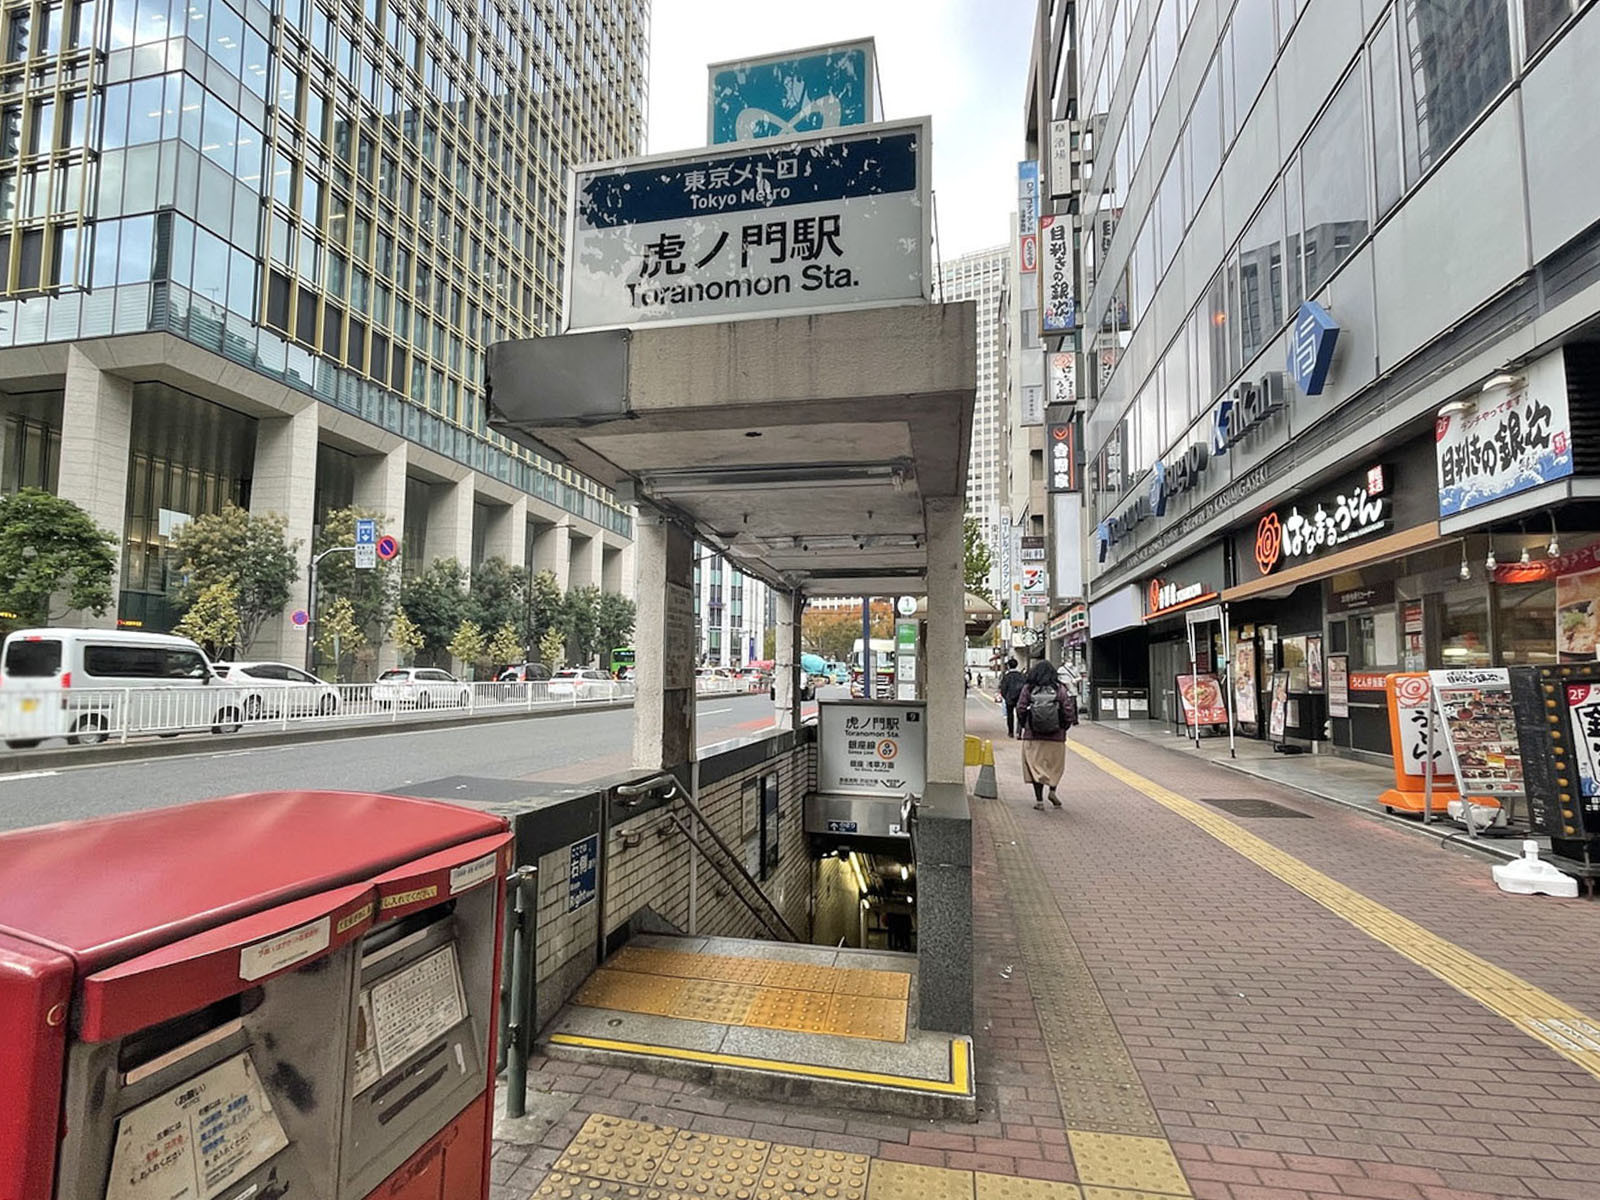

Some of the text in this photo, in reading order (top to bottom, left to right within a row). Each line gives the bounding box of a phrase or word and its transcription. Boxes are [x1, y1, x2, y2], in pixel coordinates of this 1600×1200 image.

[683, 158, 798, 193] 東京メトロ
[691, 185, 791, 211] Tokyo Metro
[639, 215, 843, 279] 虎ノ門駅
[626, 264, 859, 308] Toranomon Sta.
[1049, 224, 1070, 317] 目利きの銀次
[1211, 370, 1283, 457] Kaikan
[1441, 399, 1552, 489] 目利きの銀次
[1282, 486, 1383, 557] はなまるうどん
[1568, 688, 1585, 700] 2F
[844, 729, 885, 738] Toranomon
[845, 716, 900, 731] 虎ノ門駅
[882, 748, 892, 756] 07
